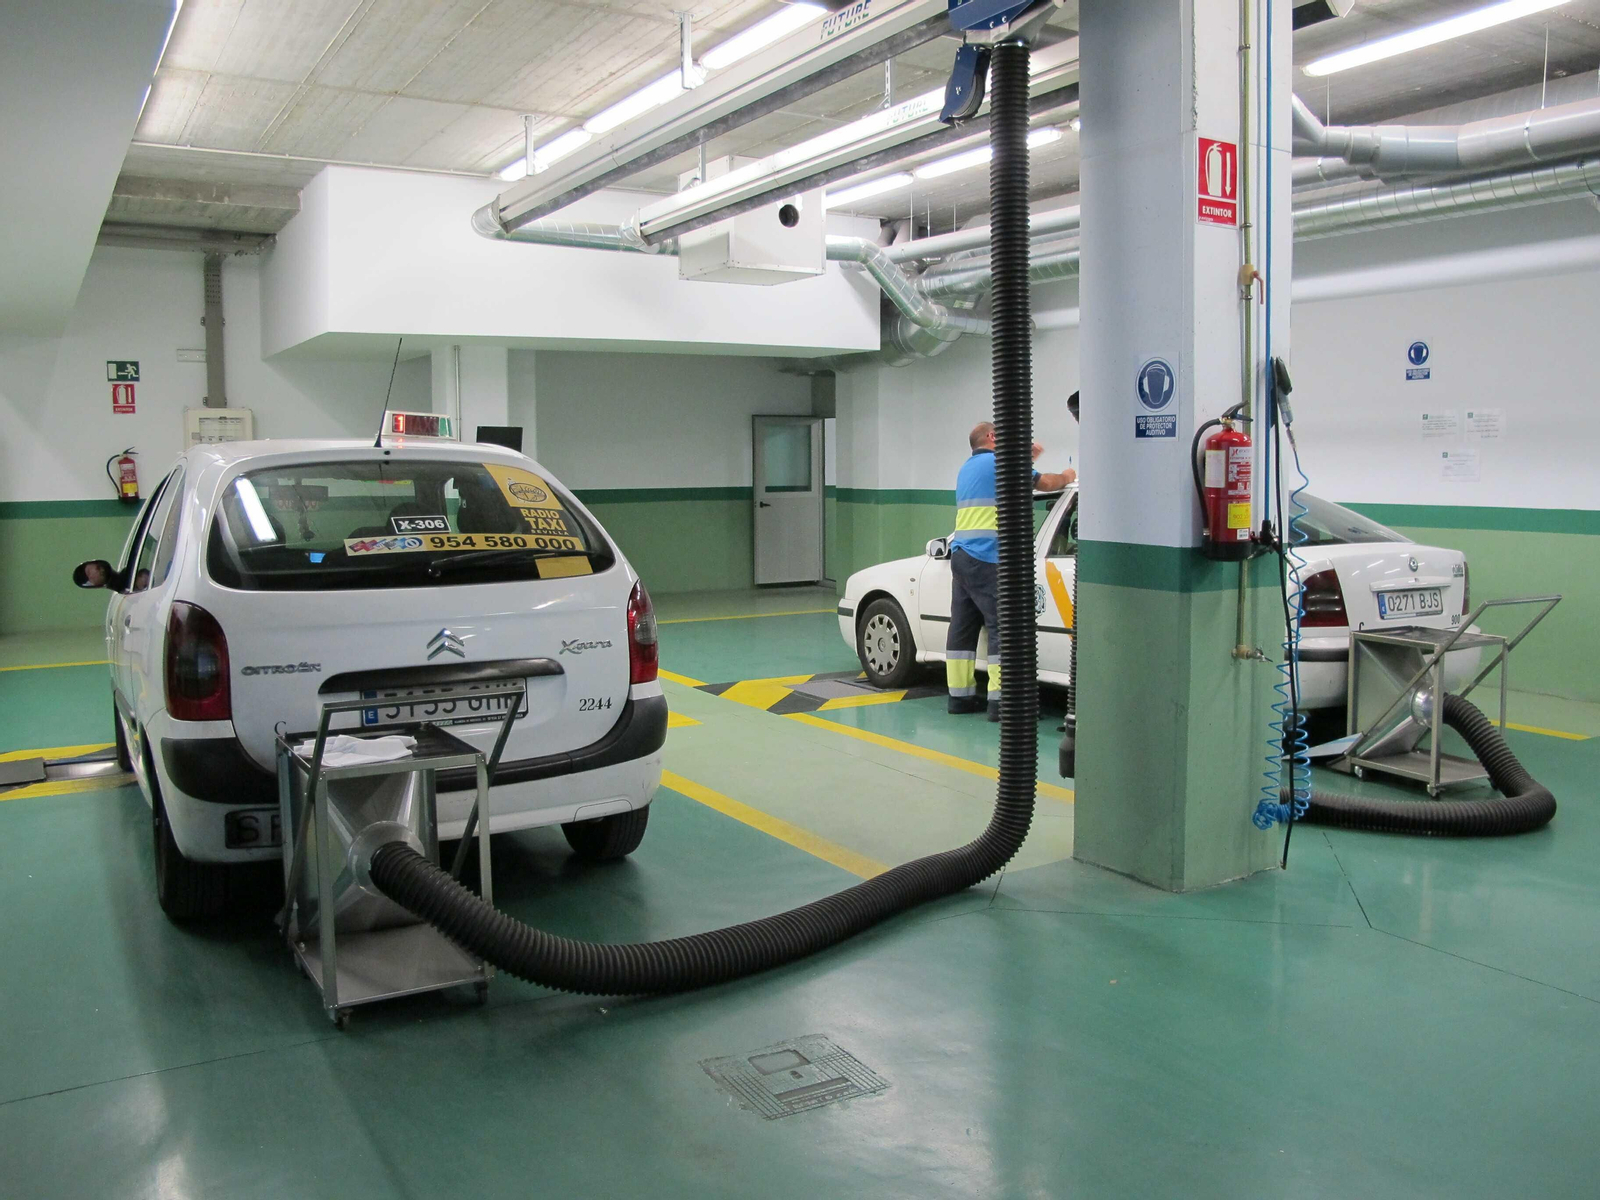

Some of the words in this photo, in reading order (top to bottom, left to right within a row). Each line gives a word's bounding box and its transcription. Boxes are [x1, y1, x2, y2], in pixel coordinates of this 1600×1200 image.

[820, 0, 871, 40] FUTURE
[1202, 205, 1233, 218] EXTINTOR
[1147, 415, 1176, 423] OBLIGATORIO
[520, 509, 560, 518] RADIO
[400, 519, 445, 530] X-306
[525, 518, 567, 530] TAXI
[430, 536, 477, 549] 954
[484, 536, 528, 548] 580
[534, 537, 576, 550] 000
[1387, 592, 1416, 612] 0271
[1418, 592, 1440, 609] BJS
[579, 697, 612, 712] 2244
[368, 711, 375, 720] E
